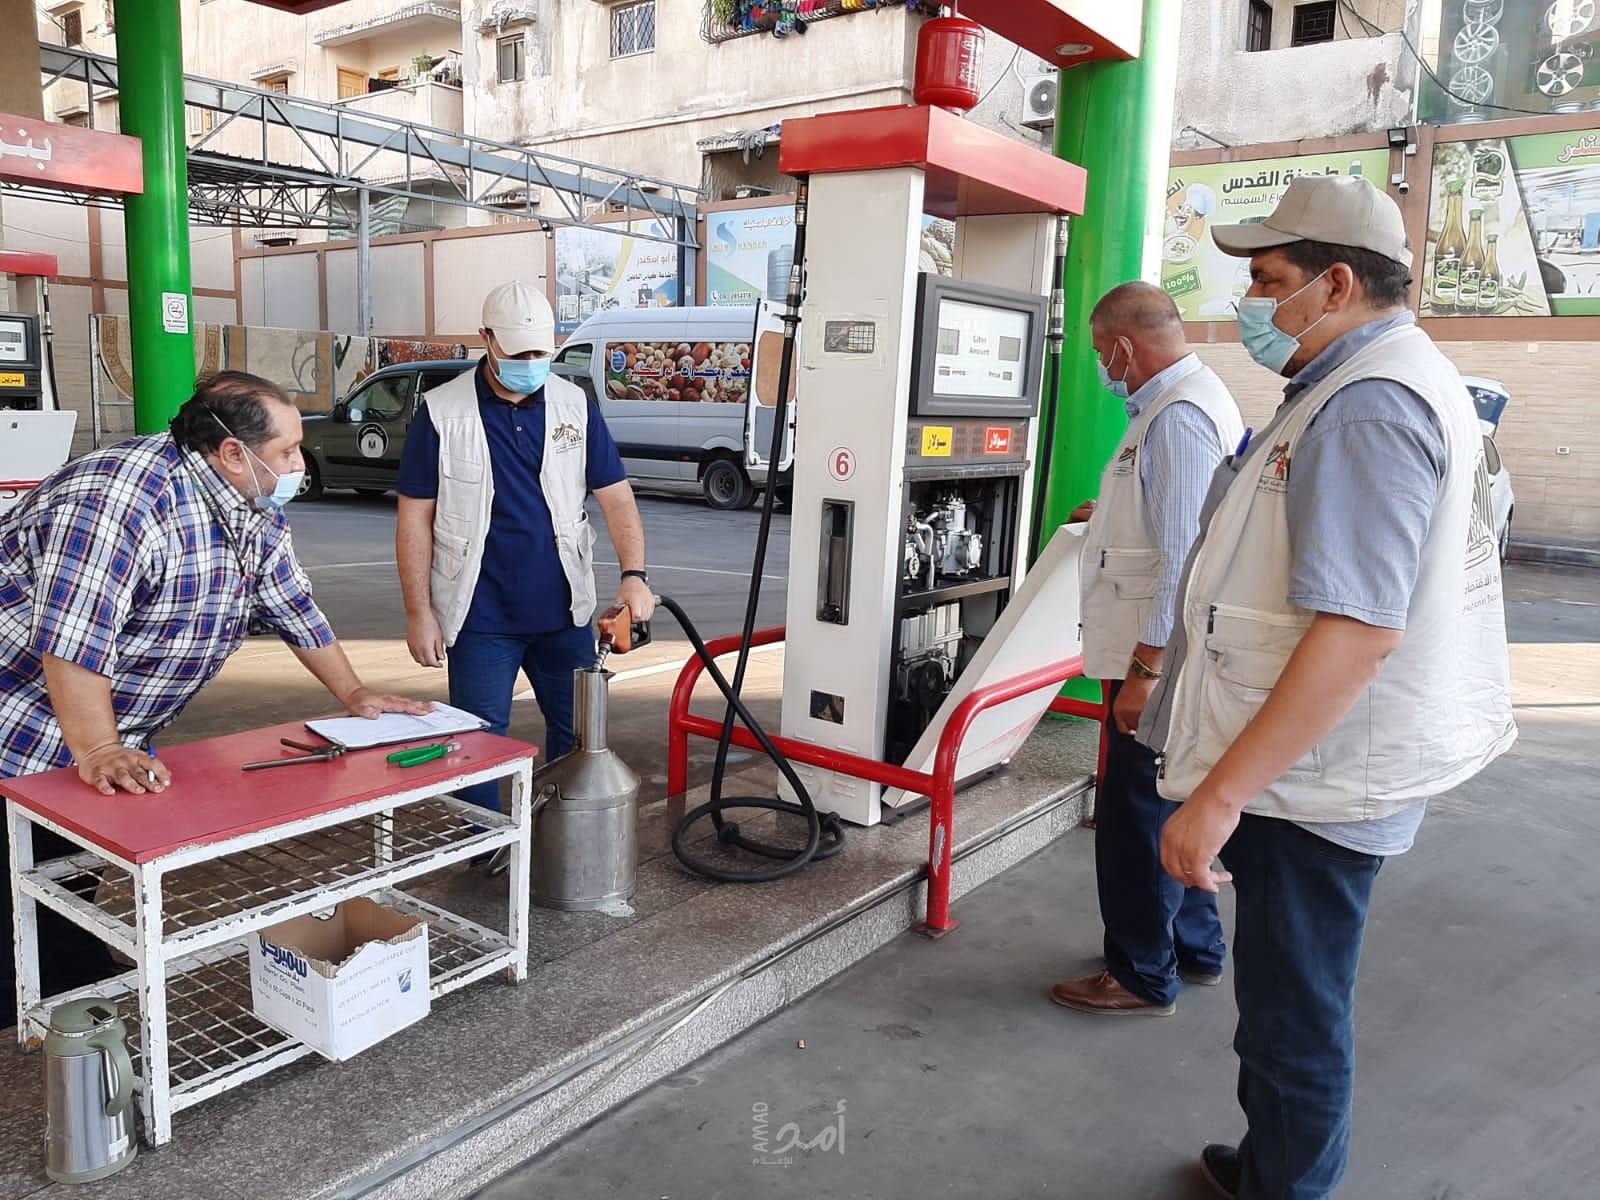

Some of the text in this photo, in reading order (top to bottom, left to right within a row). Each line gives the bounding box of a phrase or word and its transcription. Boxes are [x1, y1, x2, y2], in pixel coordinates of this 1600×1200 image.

[1222, 170, 1280, 193] القدس
[1221, 193, 1267, 207] السمسم
[1166, 272, 1195, 290] 100%
[928, 433, 947, 450] سولار
[988, 432, 1007, 449] سولار
[836, 452, 849, 475] 6
